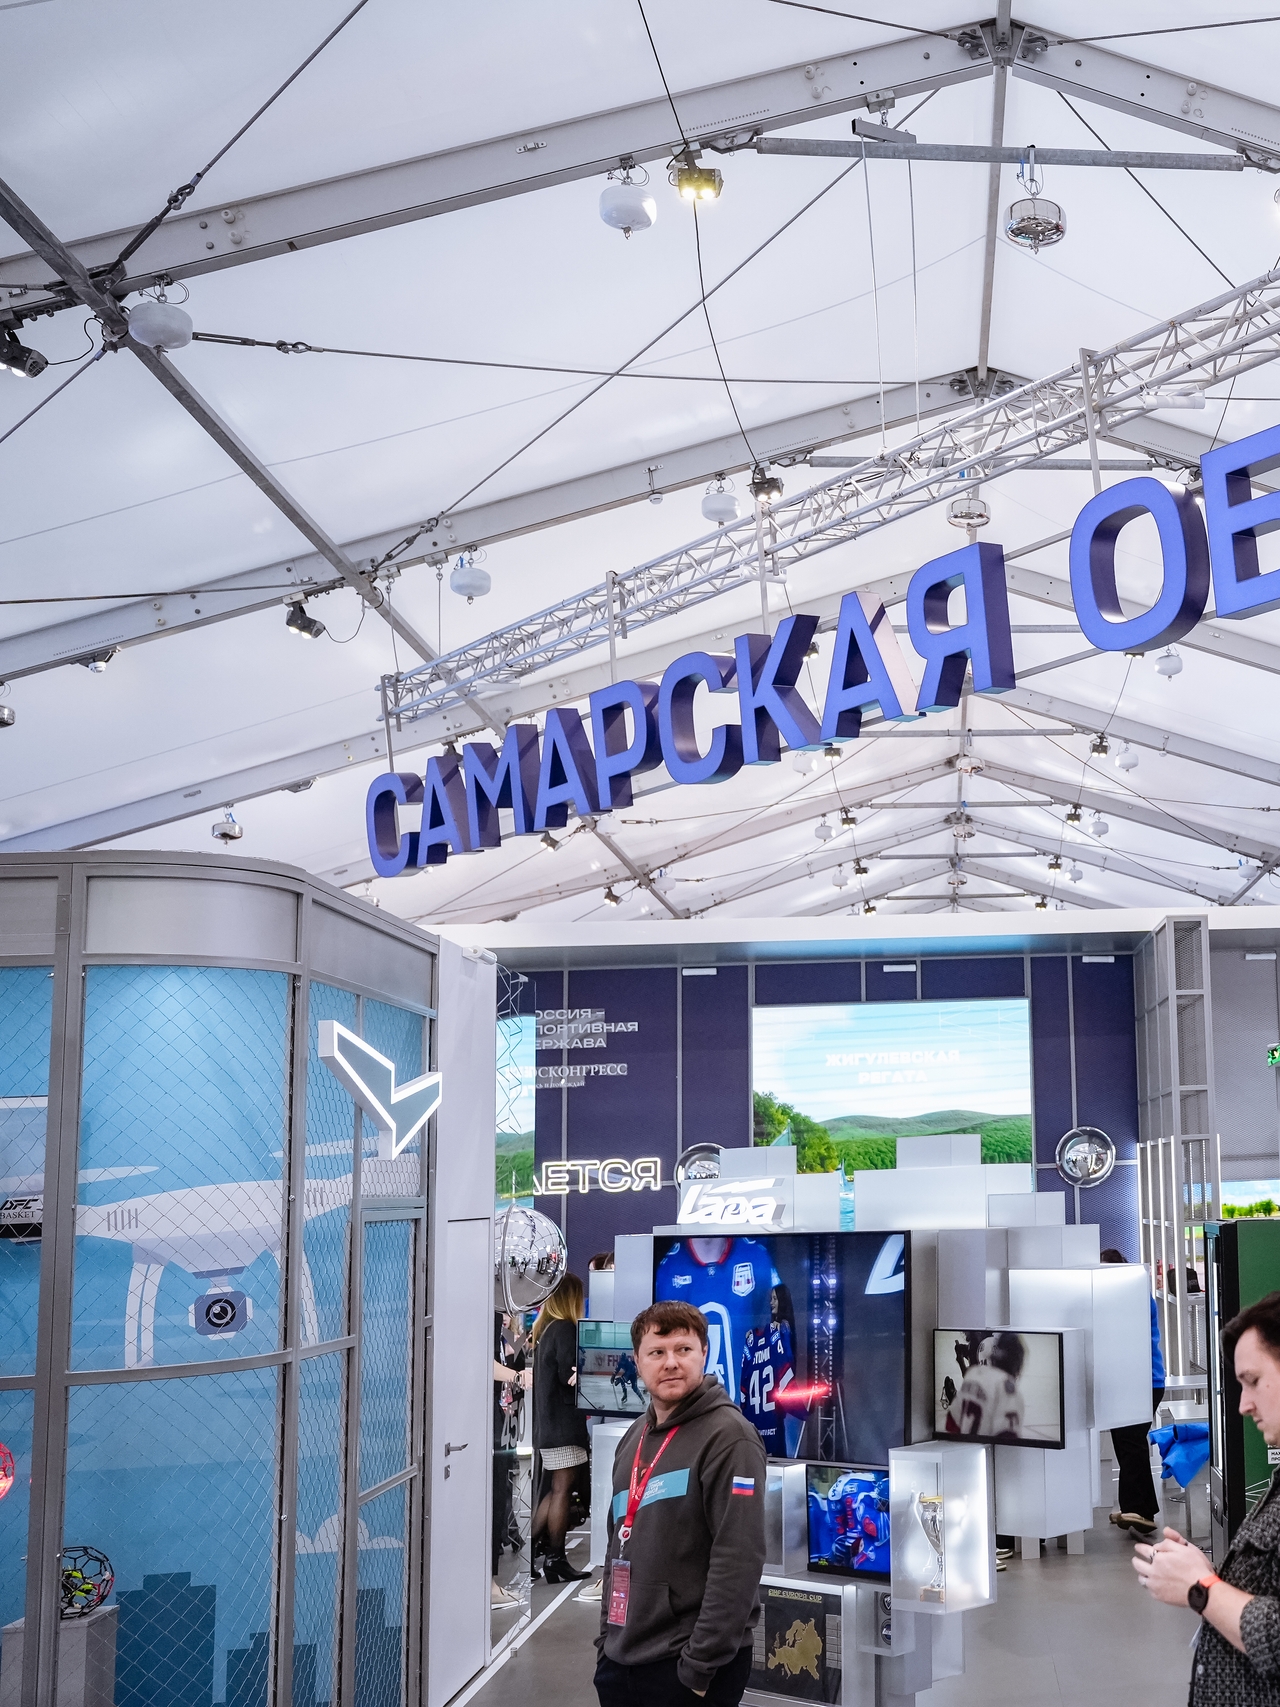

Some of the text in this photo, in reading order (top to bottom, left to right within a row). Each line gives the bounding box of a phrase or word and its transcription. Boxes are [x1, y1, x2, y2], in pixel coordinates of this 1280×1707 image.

[366, 542, 1016, 878] САМАРСКАЯ
[825, 1049, 960, 1067] ЖИГУЛЕВСКАЯ
[858, 1070, 928, 1085] РЕГАТА
[0, 1211, 36, 1220] BASKET
[749, 1365, 776, 1415] 42
